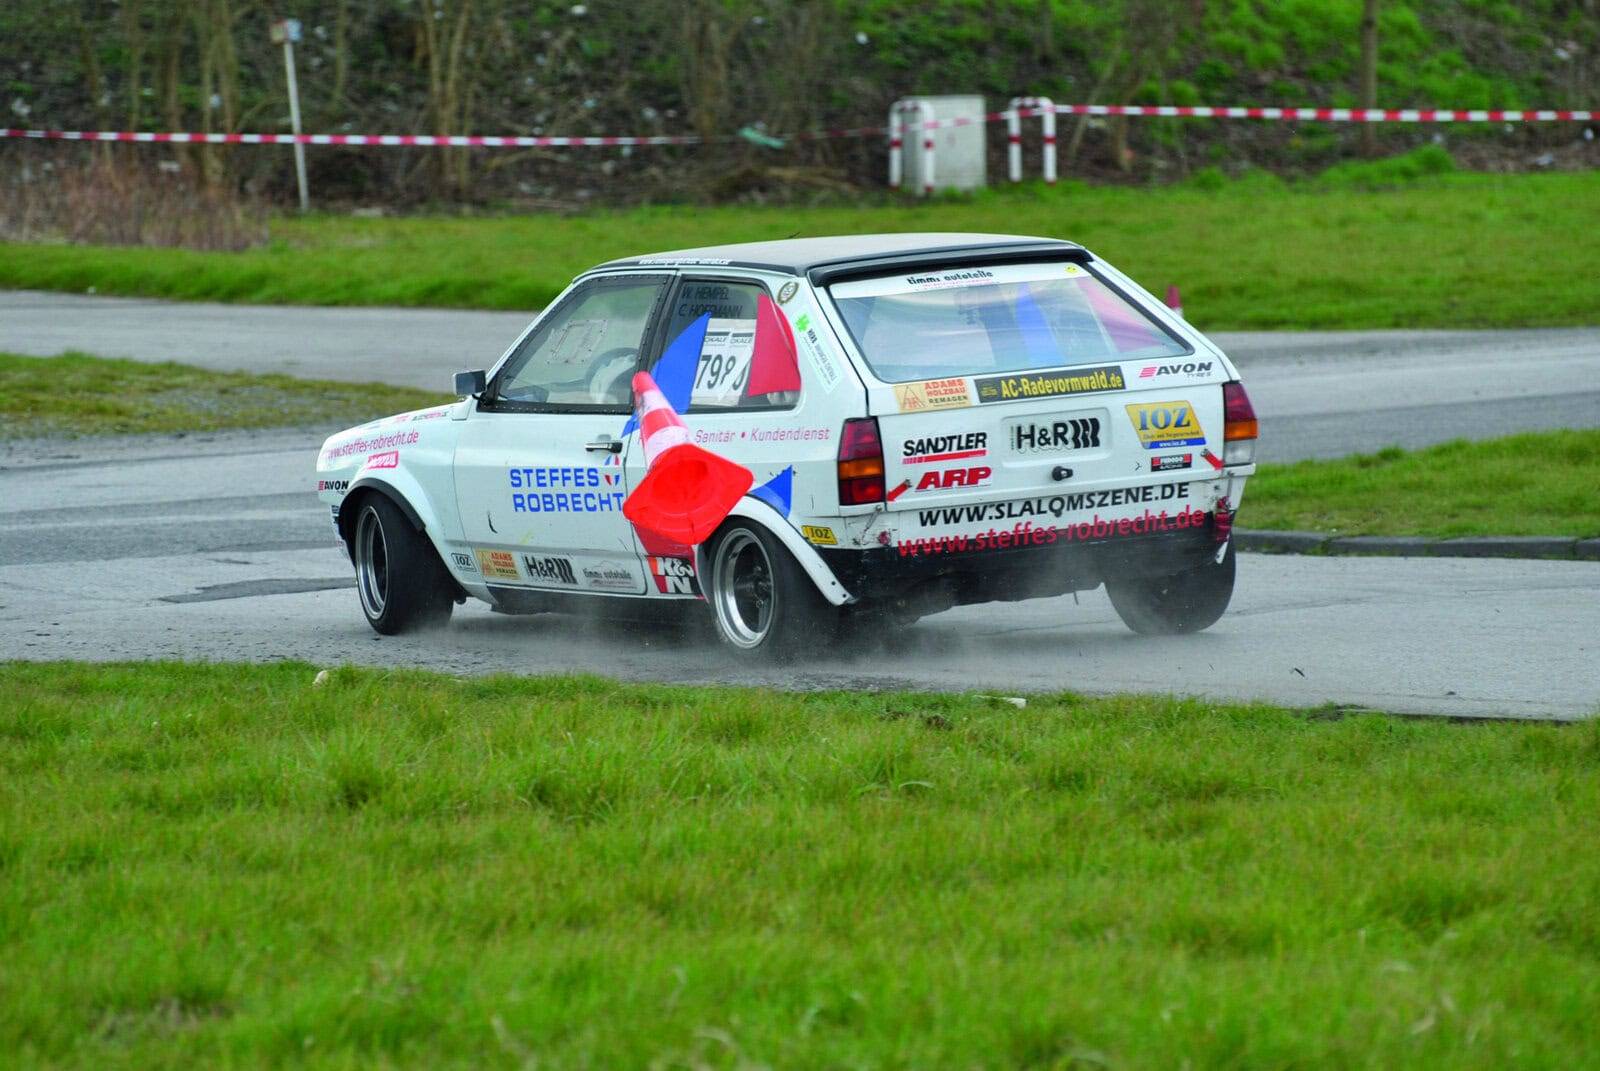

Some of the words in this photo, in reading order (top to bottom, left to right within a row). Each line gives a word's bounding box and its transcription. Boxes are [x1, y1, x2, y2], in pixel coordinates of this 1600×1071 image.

[1157, 361, 1213, 376] AVON
[925, 378, 965, 390] ADAMS
[1000, 370, 1123, 399] AC-Radevormwald.de
[751, 427, 832, 441] Kundendienst
[902, 432, 988, 456] SANDTLER
[324, 480, 349, 491] AVON
[509, 468, 600, 488] STEFFES
[915, 466, 992, 491] ARP
[512, 492, 624, 513] ROBRECHT
[919, 481, 1190, 526] WWW.SLALOMSZENE.DE
[898, 505, 1206, 557] www.steffes-robrecht.de
